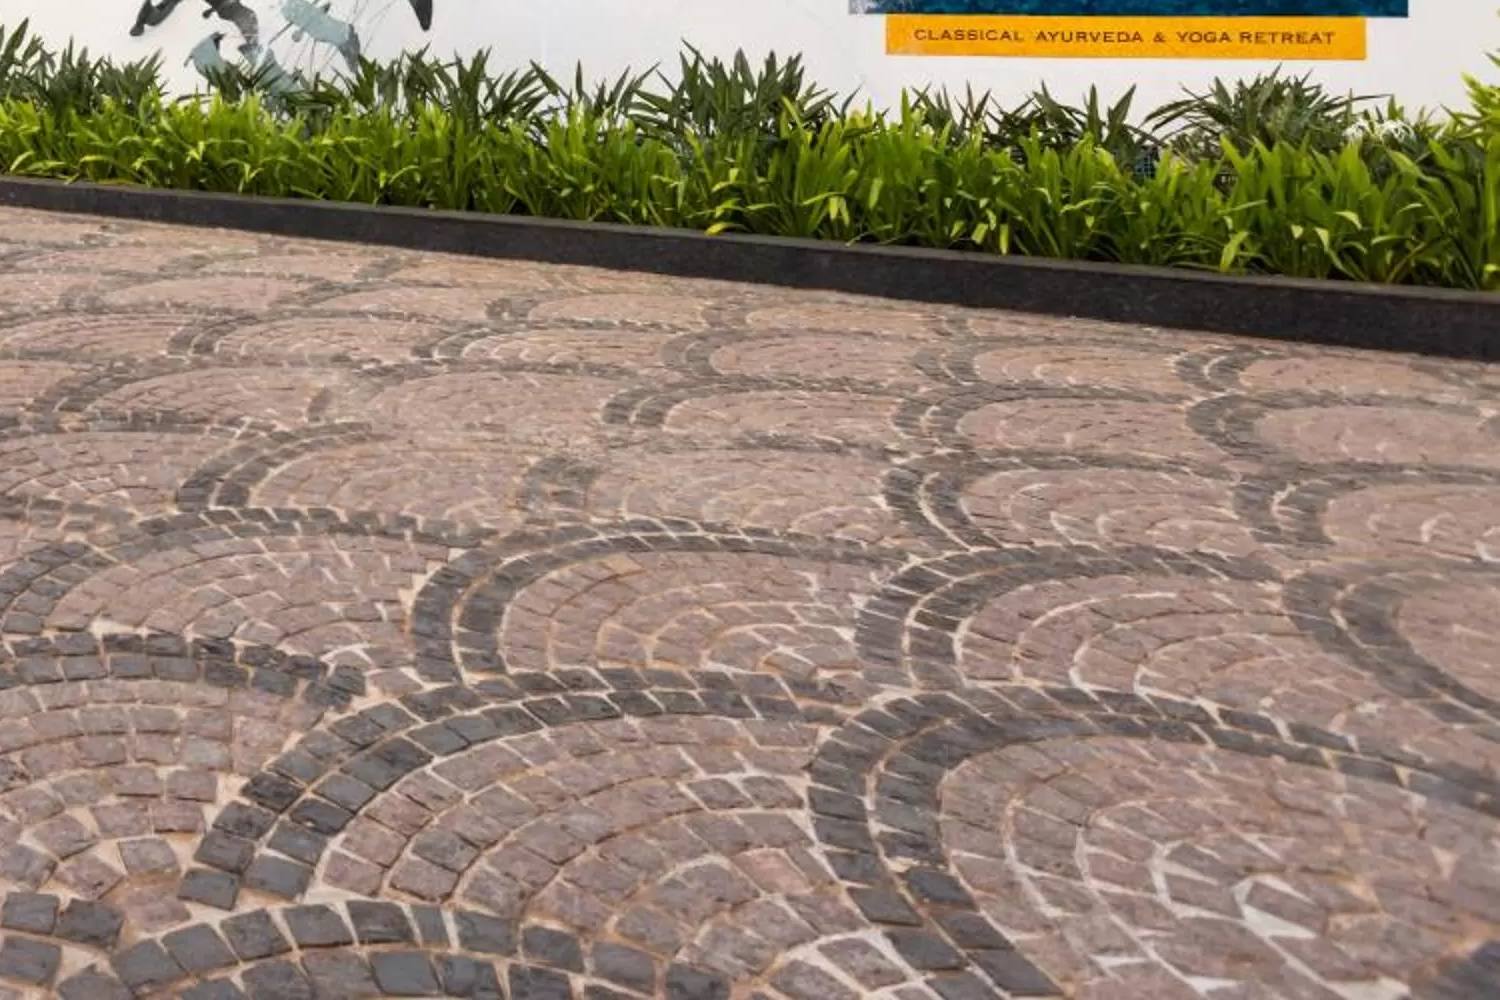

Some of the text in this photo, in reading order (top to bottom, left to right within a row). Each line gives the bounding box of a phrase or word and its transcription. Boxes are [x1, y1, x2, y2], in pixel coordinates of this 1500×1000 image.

[913, 28, 1336, 45] CLASSICAL AYURVEDA & YOGA RETREAT
